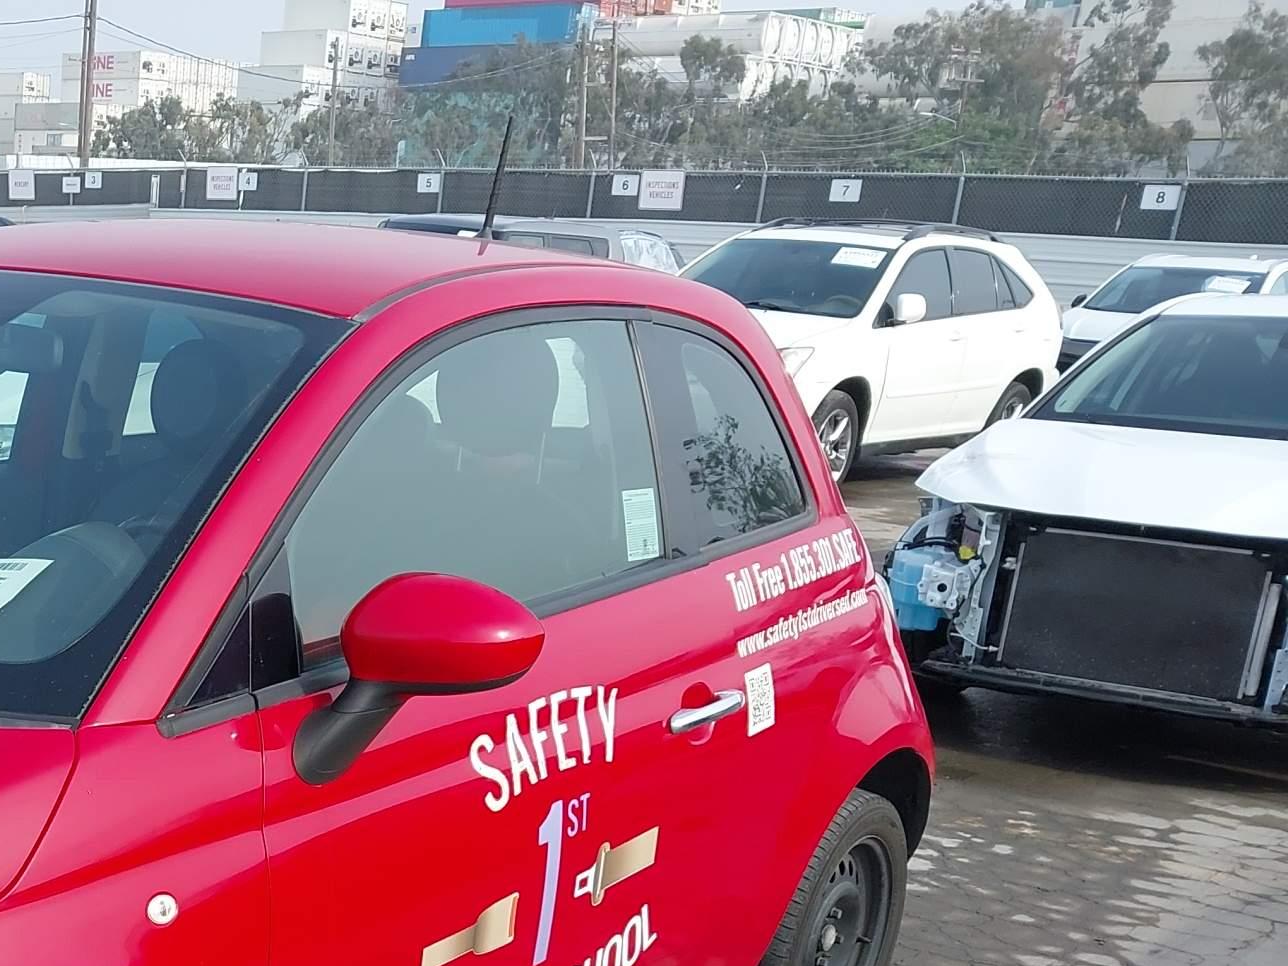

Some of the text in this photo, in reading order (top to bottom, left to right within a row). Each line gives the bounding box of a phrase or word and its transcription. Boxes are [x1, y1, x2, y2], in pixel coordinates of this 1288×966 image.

[91, 175, 96, 185] 3
[245, 176, 251, 186] 4
[425, 178, 432, 188] 5
[622, 179, 629, 191] 6
[842, 185, 850, 196] 7
[1155, 191, 1166, 204] 8
[725, 571, 758, 612] Toll
[751, 562, 786, 602] Free
[736, 588, 869, 658] www.safety1stdriversed.com
[470, 684, 618, 813] SAFETY
